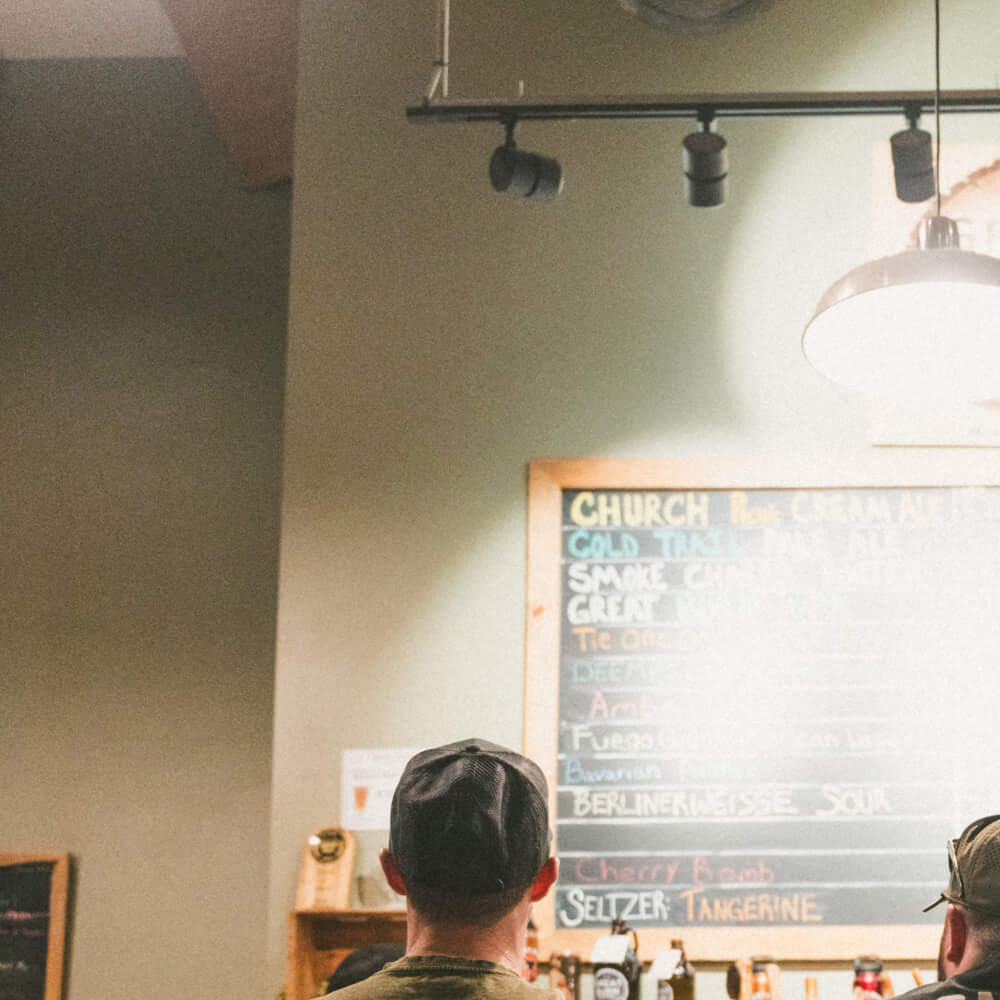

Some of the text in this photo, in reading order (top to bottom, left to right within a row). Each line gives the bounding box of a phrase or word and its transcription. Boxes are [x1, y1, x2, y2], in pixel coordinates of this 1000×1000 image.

[570, 491, 709, 527] CHURCH
[568, 530, 640, 560] COLD
[652, 528, 744, 559] TRAIL
[568, 562, 668, 593] SMOKE
[566, 594, 656, 625] GREAT
[572, 724, 653, 752] Fuego
[815, 784, 892, 816] SOUR
[576, 855, 776, 885] Cherry Bomb
[680, 887, 823, 922] TANGERINE
